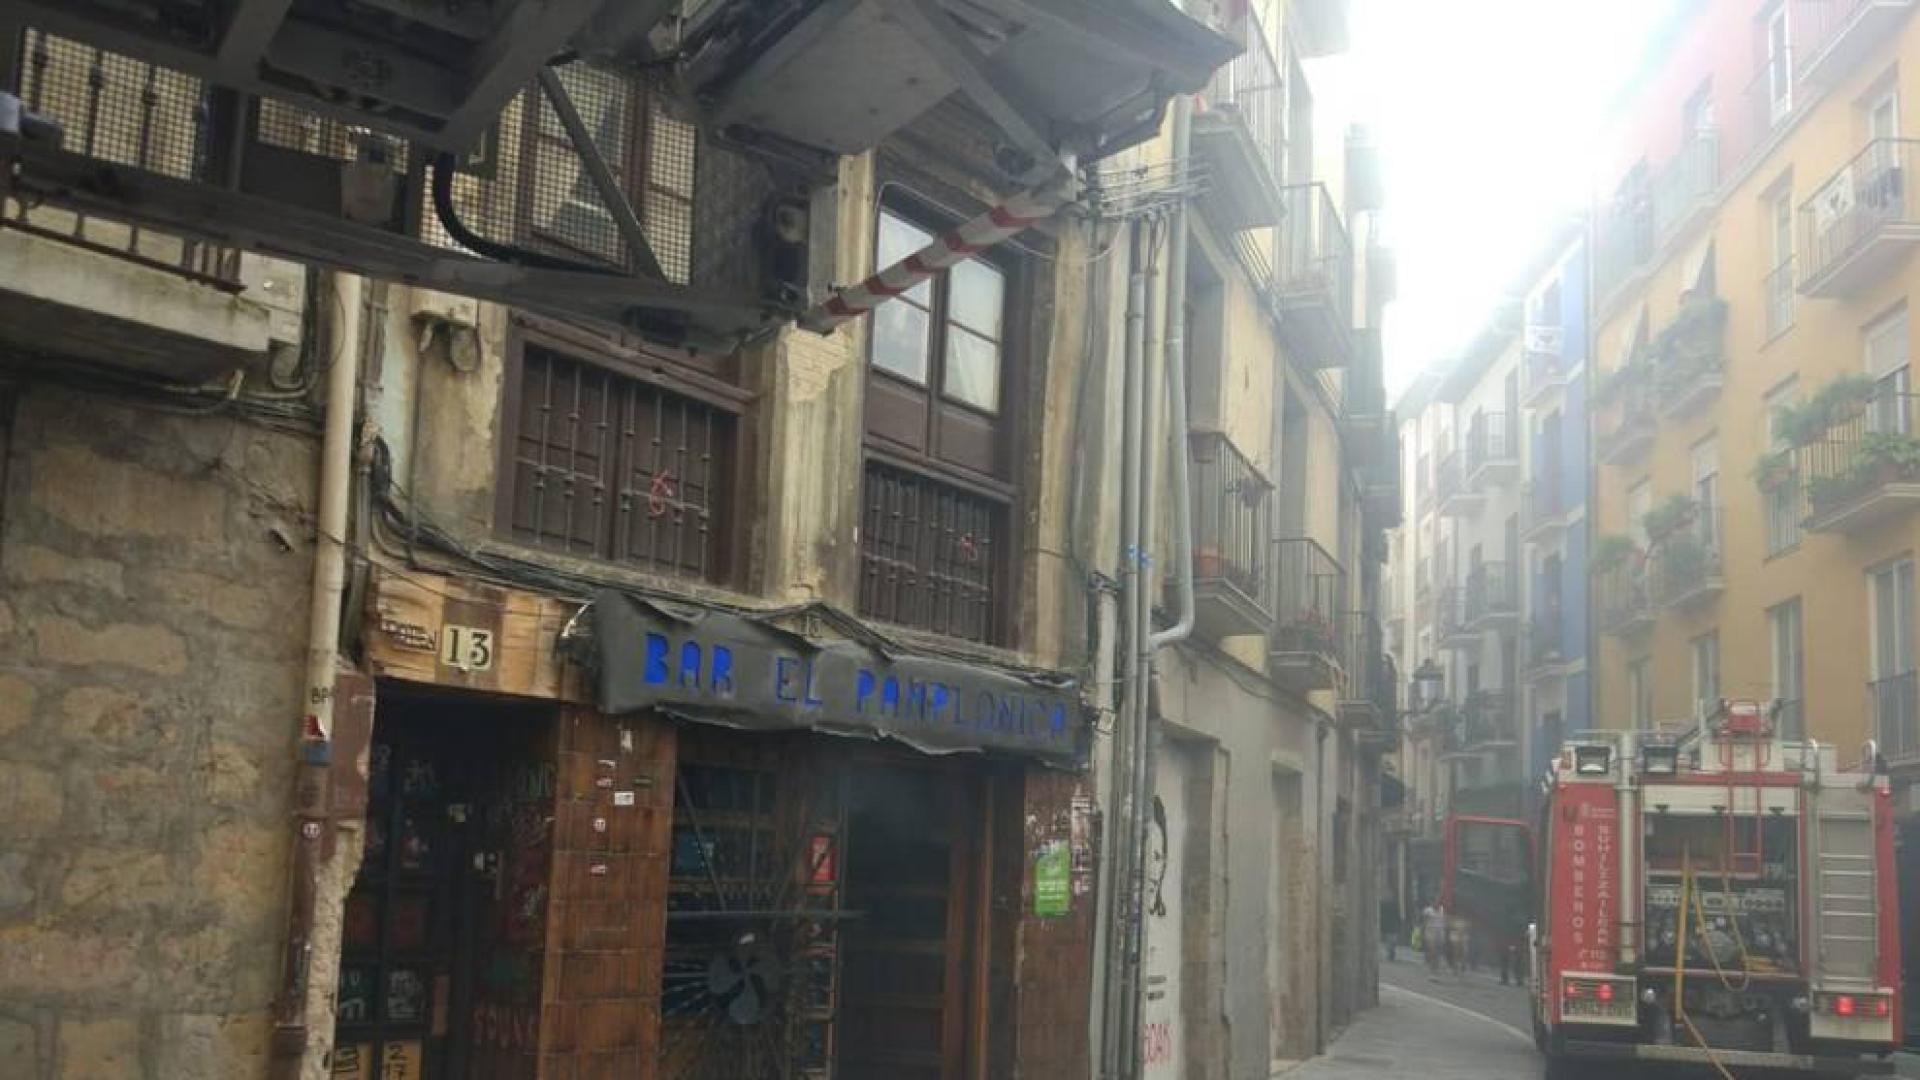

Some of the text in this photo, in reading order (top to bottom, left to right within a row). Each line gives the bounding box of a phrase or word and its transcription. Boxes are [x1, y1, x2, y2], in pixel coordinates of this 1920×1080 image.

[448, 628, 490, 667] 13
[643, 632, 733, 694] BAR
[776, 656, 823, 705] EL
